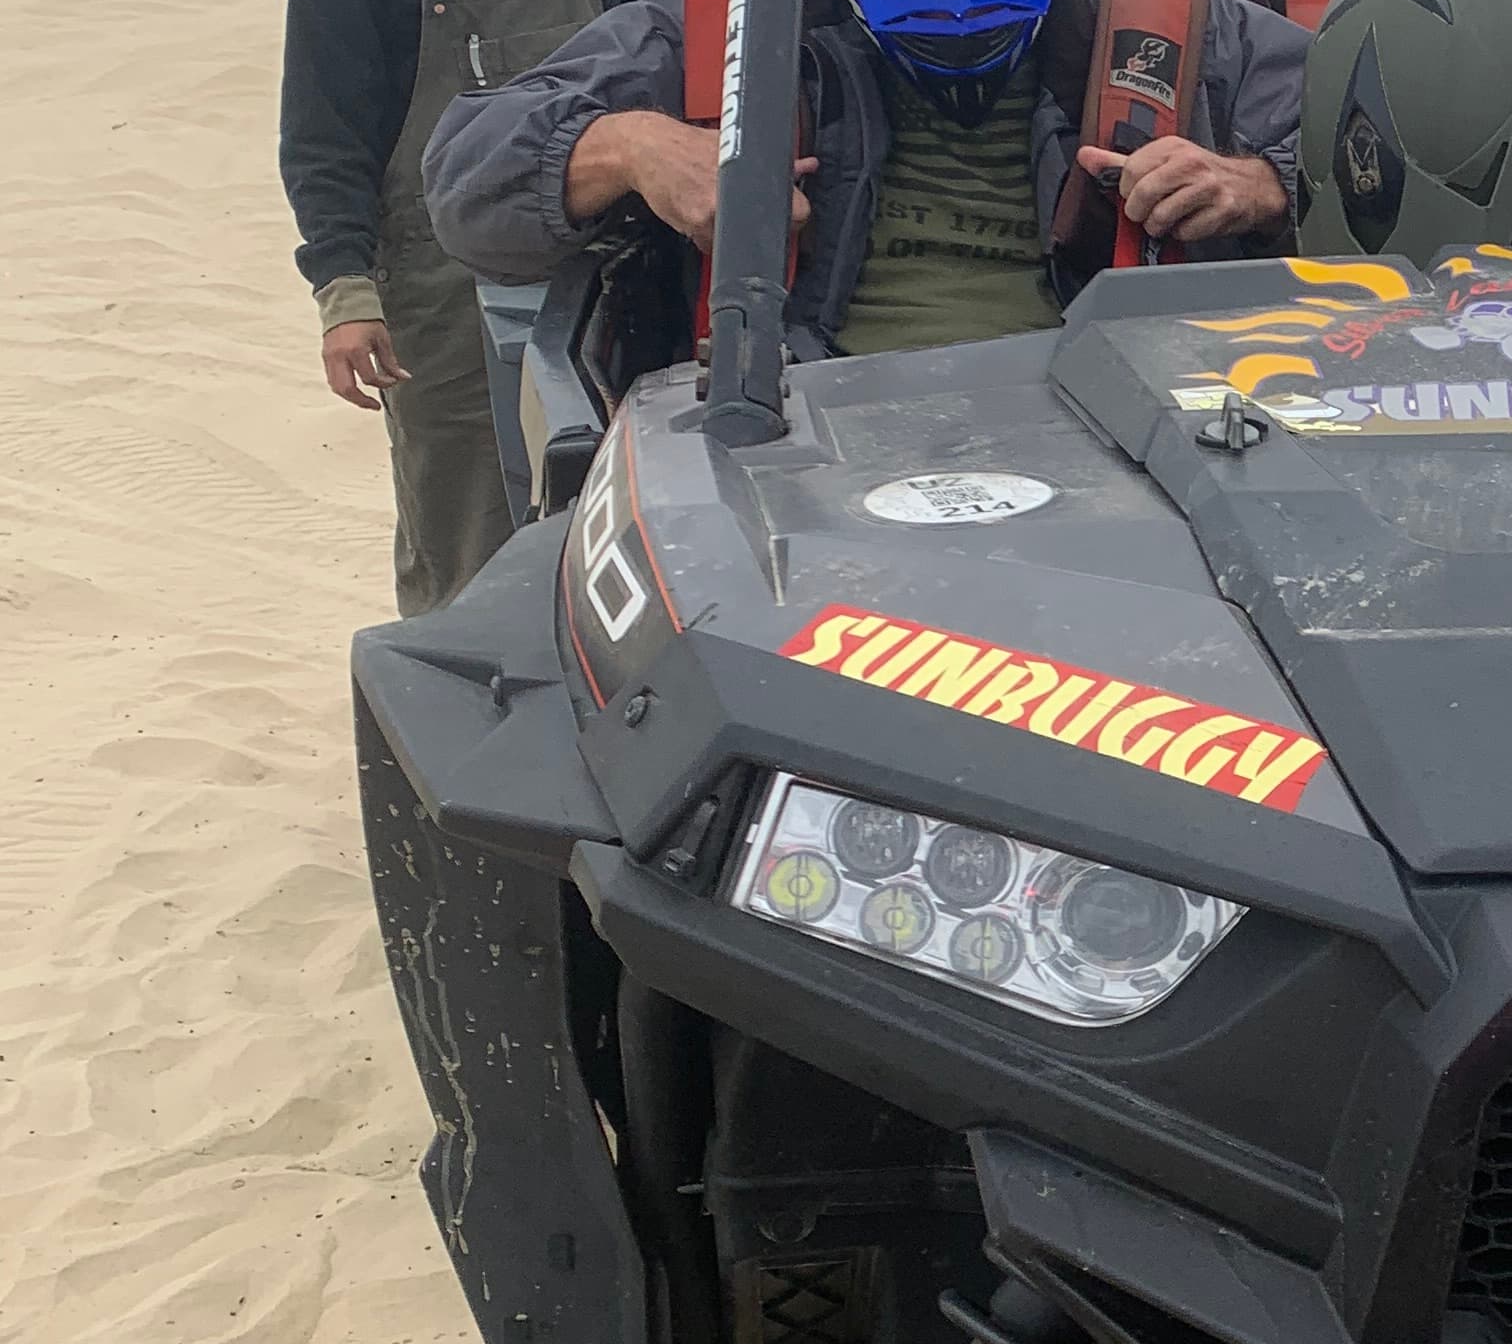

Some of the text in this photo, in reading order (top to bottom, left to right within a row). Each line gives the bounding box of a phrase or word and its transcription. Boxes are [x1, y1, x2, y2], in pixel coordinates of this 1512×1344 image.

[1115, 70, 1171, 99] DragonFire
[879, 199, 932, 225] ST
[792, 614, 1327, 805] SUNBUGGY
